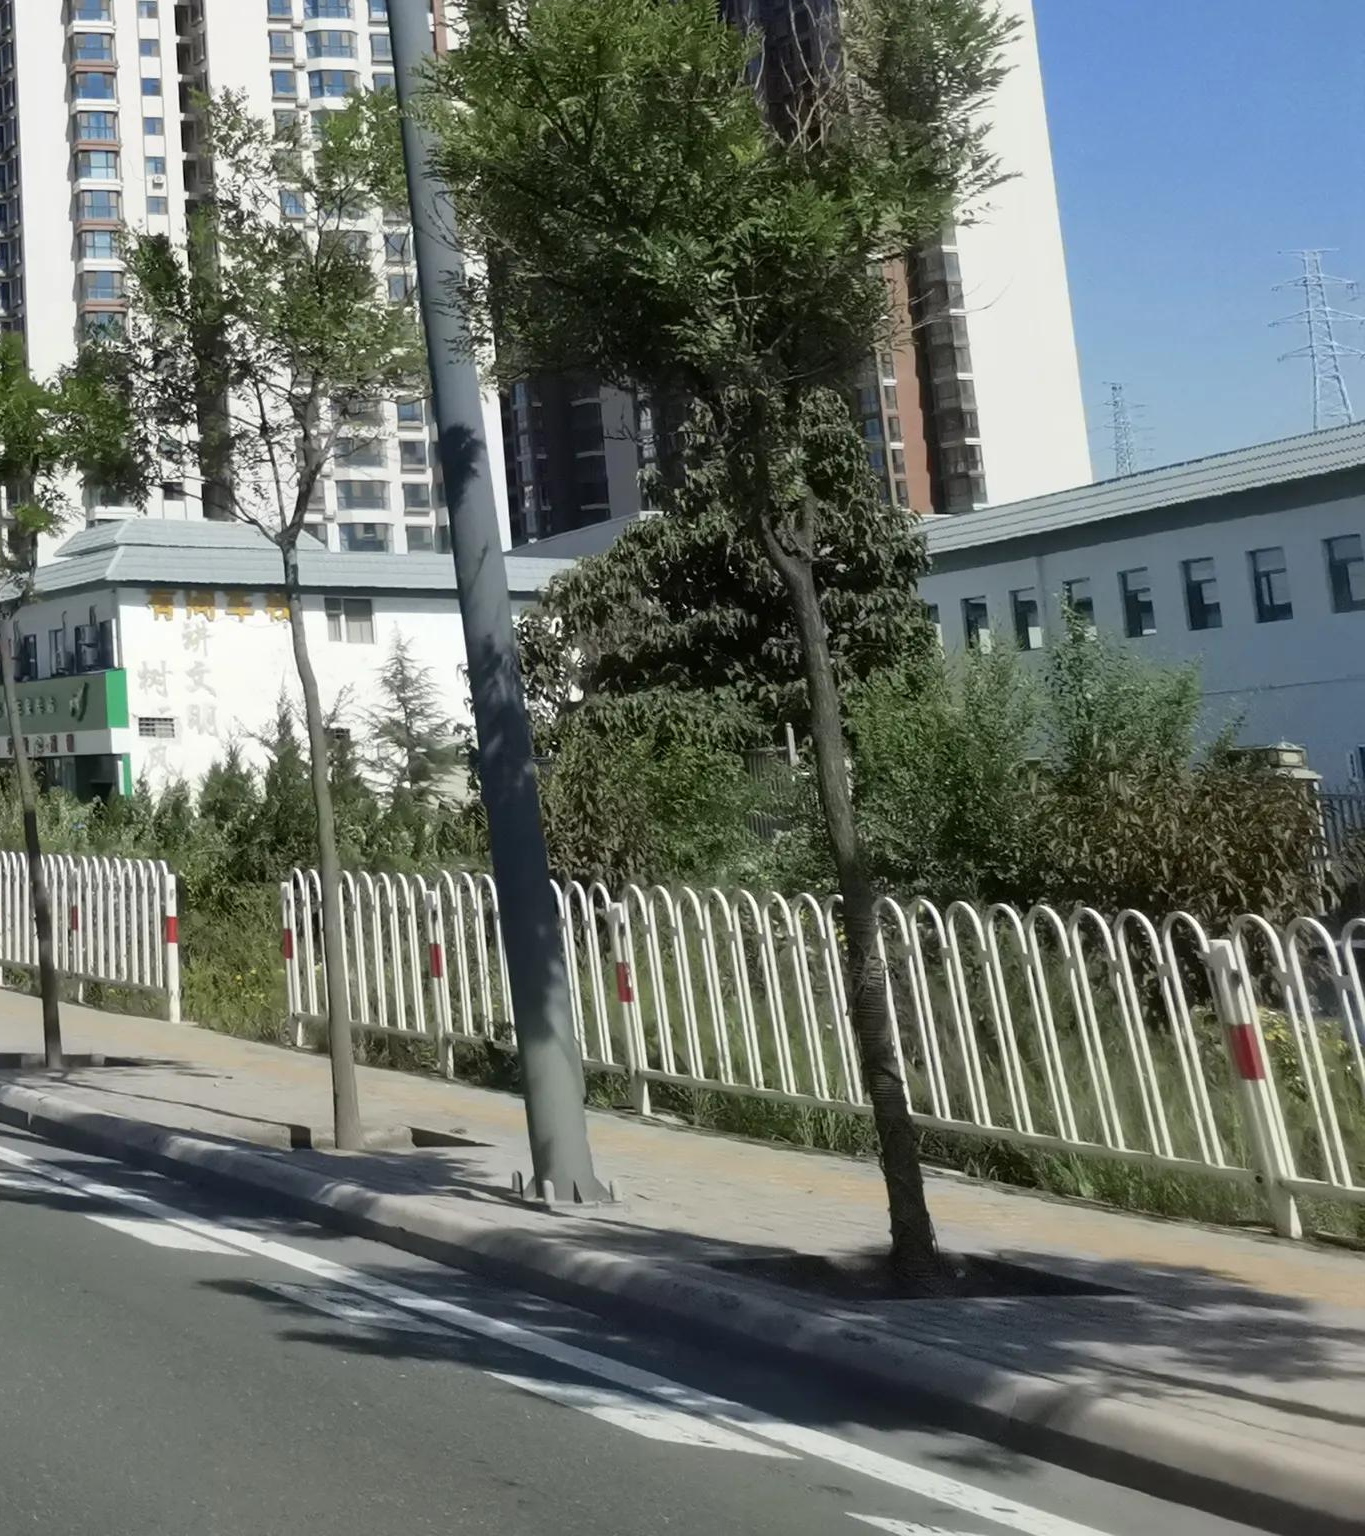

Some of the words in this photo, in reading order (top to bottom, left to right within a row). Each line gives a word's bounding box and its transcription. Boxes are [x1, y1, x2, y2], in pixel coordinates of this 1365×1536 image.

[136, 659, 180, 777] 树风
[181, 619, 219, 737] 讲文明
